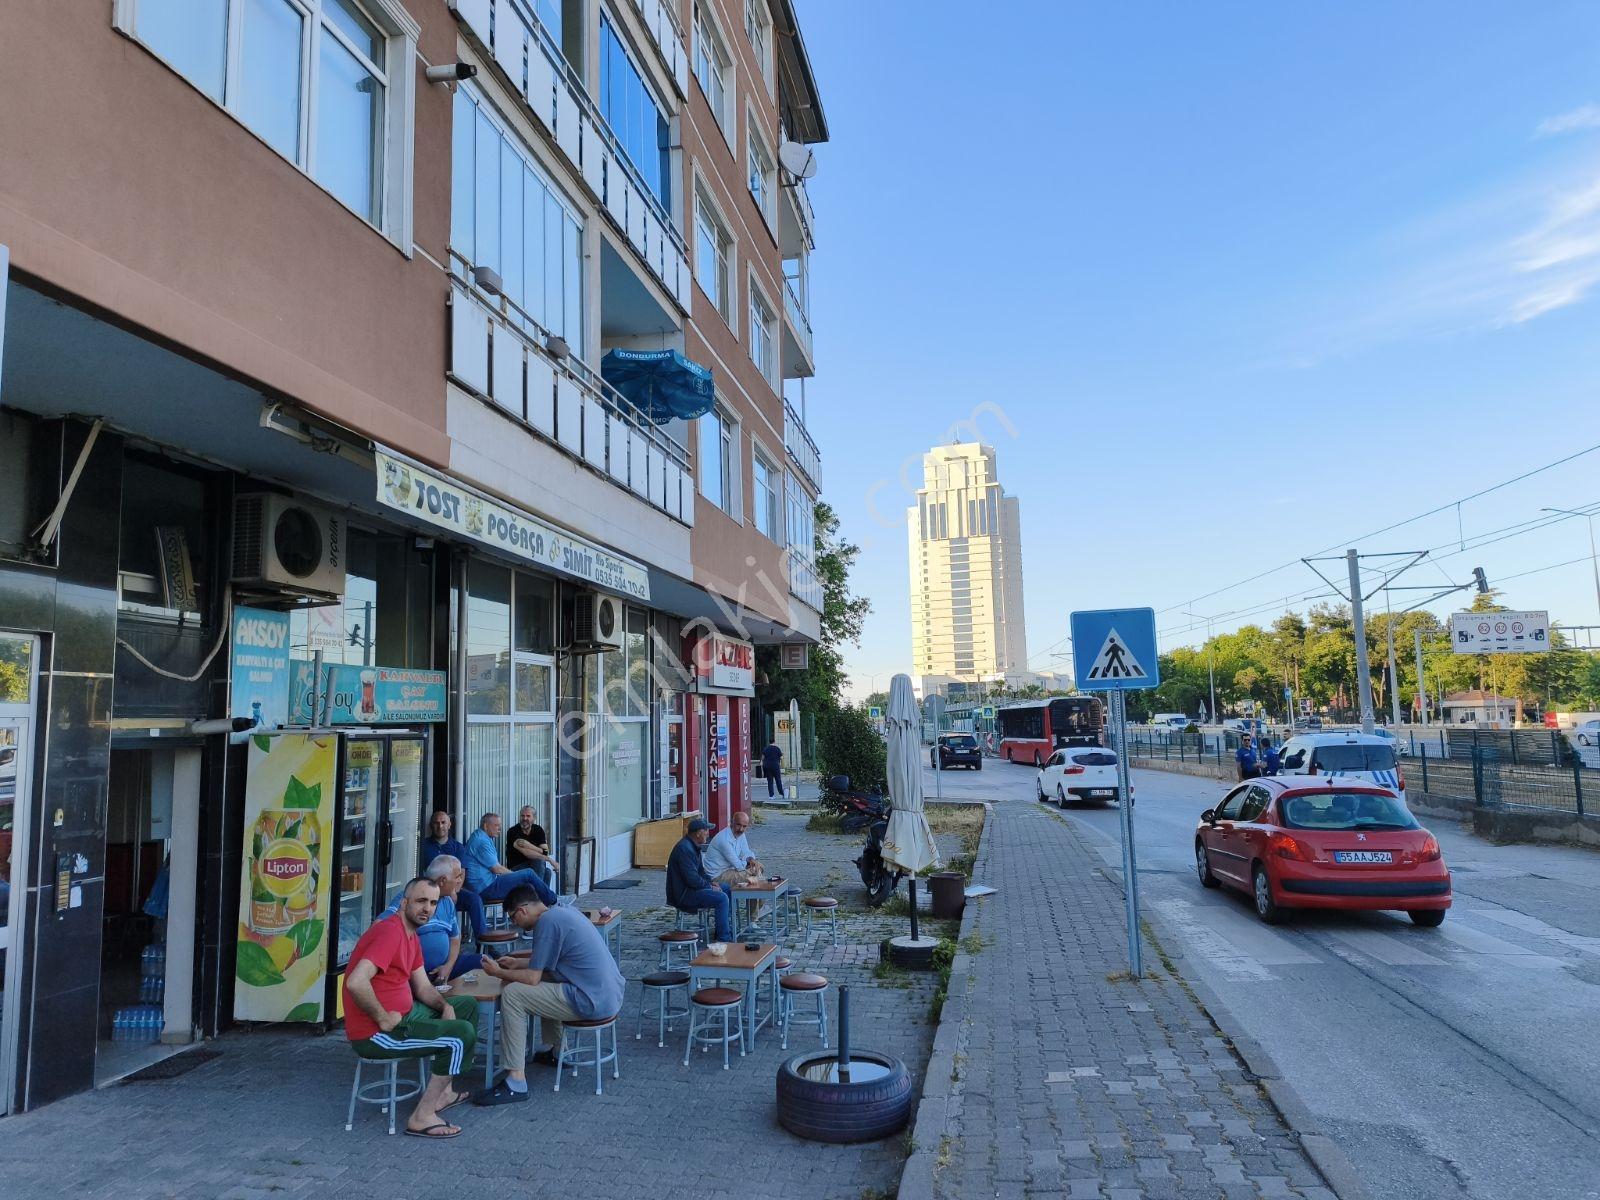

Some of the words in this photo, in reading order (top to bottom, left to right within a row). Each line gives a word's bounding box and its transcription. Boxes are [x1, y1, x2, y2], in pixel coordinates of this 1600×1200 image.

[619, 351, 671, 359] DONDURMA
[414, 478, 461, 523] TOST
[487, 512, 544, 558] POĞAÇA
[563, 541, 593, 577] SİMİT
[235, 617, 288, 649] AKSOY
[709, 711, 719, 792] ECZANE
[267, 861, 304, 876] Lipton
